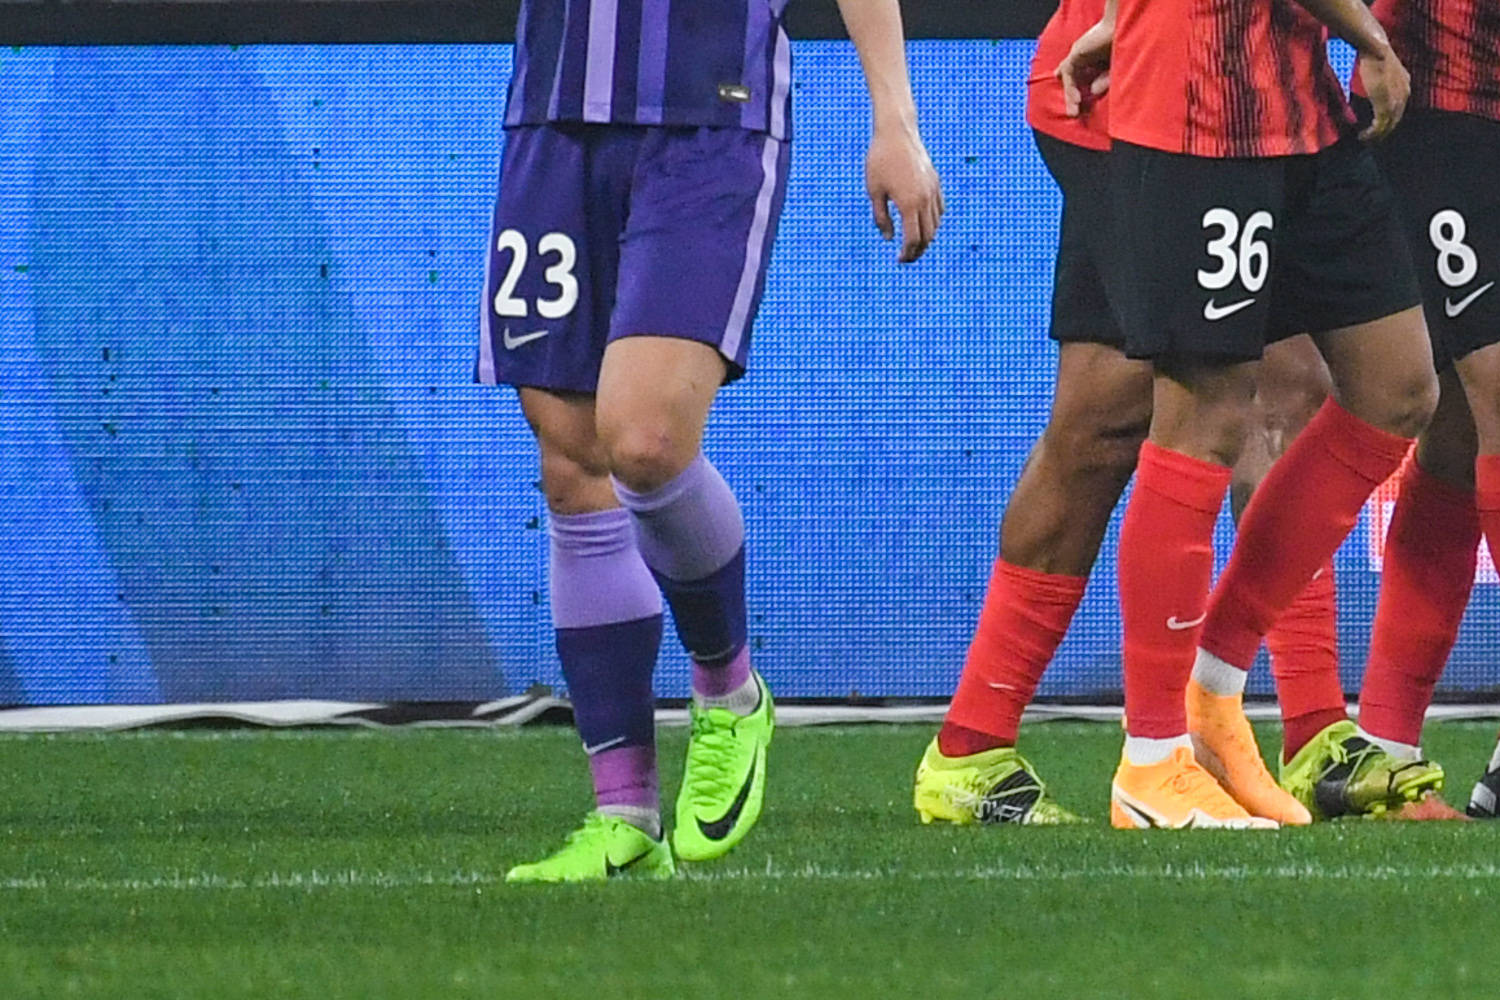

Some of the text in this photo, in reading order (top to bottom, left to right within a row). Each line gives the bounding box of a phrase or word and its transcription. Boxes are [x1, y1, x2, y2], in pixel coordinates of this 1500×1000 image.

[494, 228, 579, 319] 23
[1197, 207, 1274, 293] 36
[1428, 209, 1478, 287] 8
